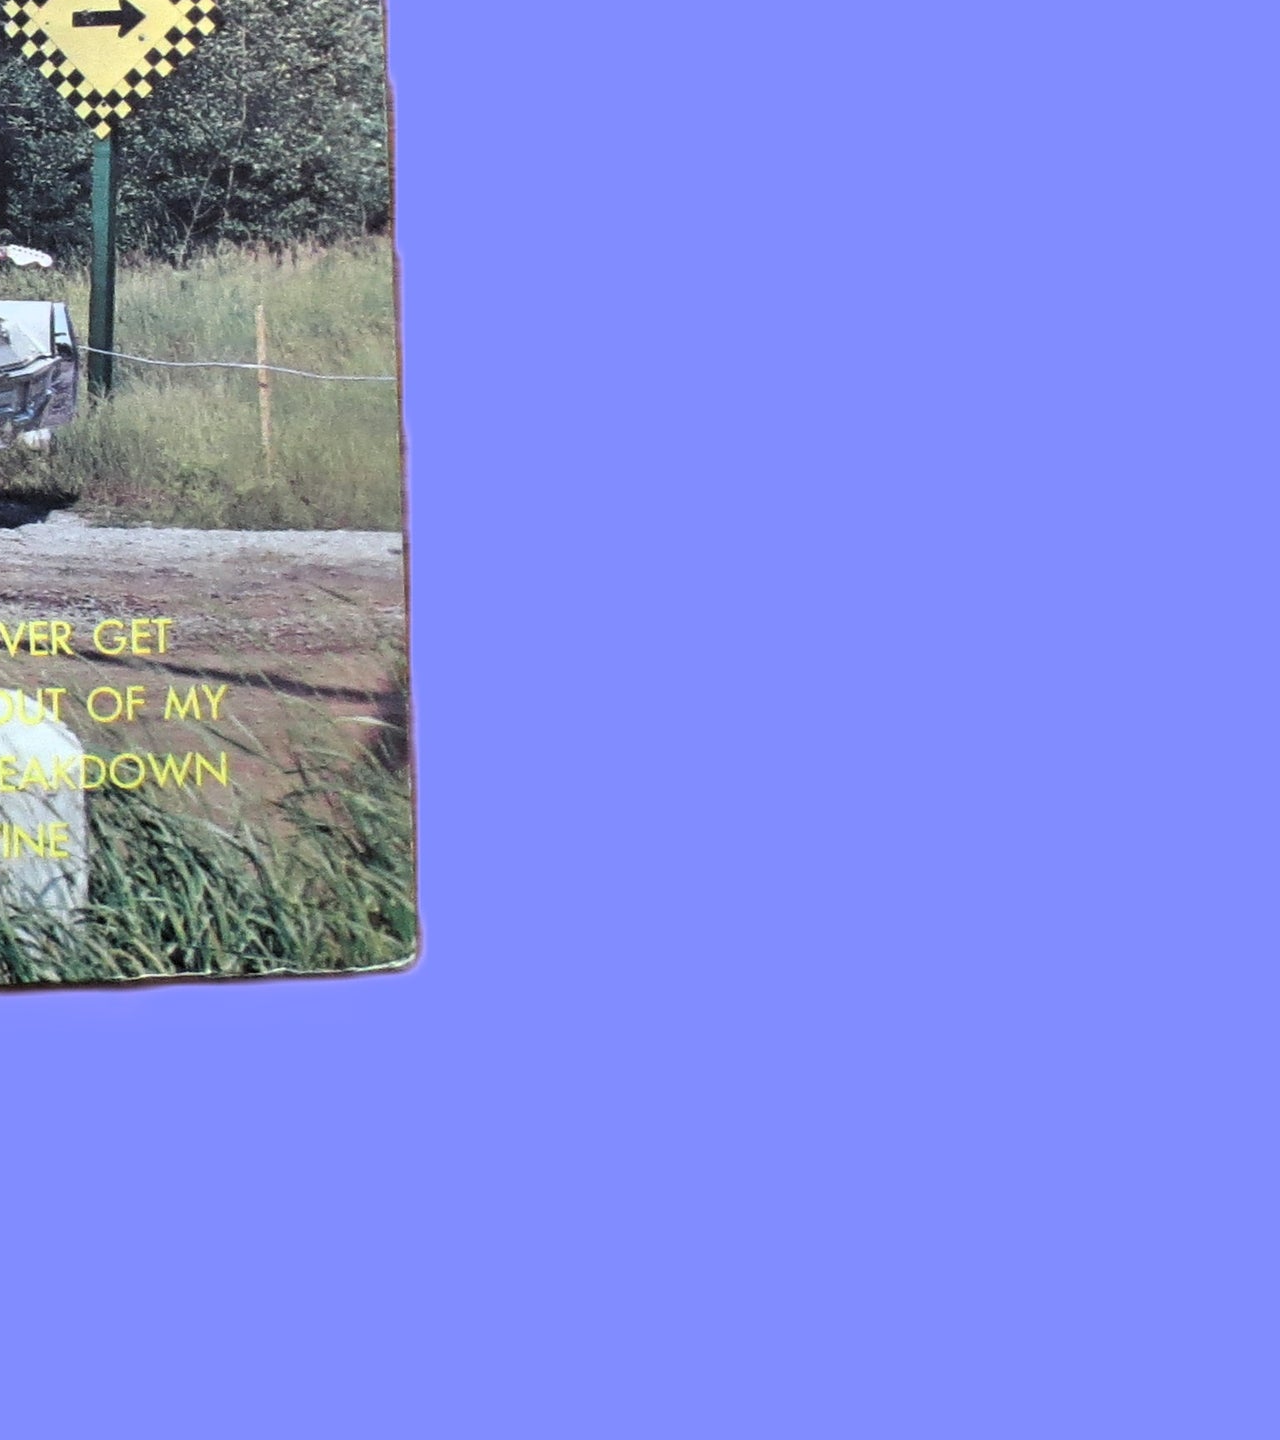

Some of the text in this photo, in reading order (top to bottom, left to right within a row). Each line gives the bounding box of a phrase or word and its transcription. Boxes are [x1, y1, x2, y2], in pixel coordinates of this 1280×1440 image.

[94, 618, 172, 655] GET
[87, 686, 145, 723] OF
[165, 684, 228, 720] MY
